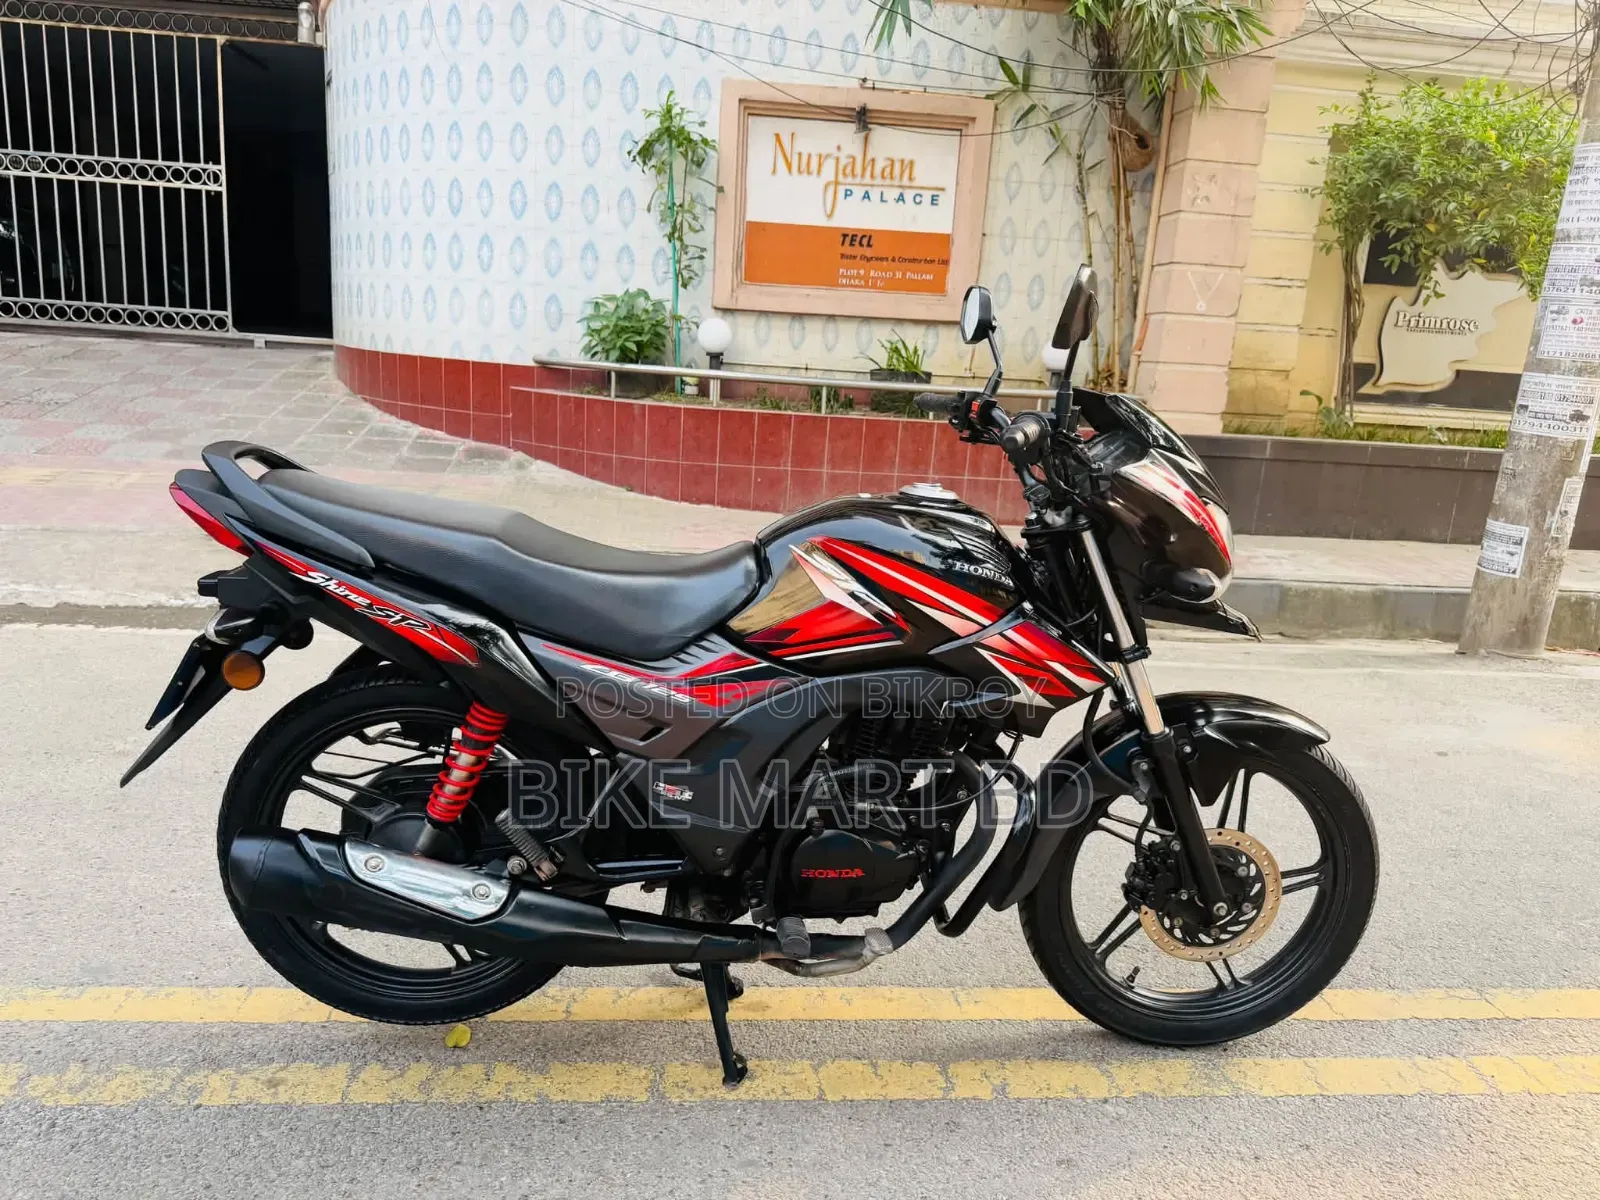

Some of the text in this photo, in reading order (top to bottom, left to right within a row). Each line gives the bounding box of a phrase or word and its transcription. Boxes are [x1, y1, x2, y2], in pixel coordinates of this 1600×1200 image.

[771, 131, 917, 219] Nurjahan
[843, 188, 940, 206] PALACE
[841, 233, 873, 248] TECL
[870, 269, 893, 278] ROAD
[1394, 310, 1479, 332] Primrose
[953, 561, 1015, 589] HONDA
[304, 571, 422, 632] Shine SP
[800, 868, 866, 878] HONDA
